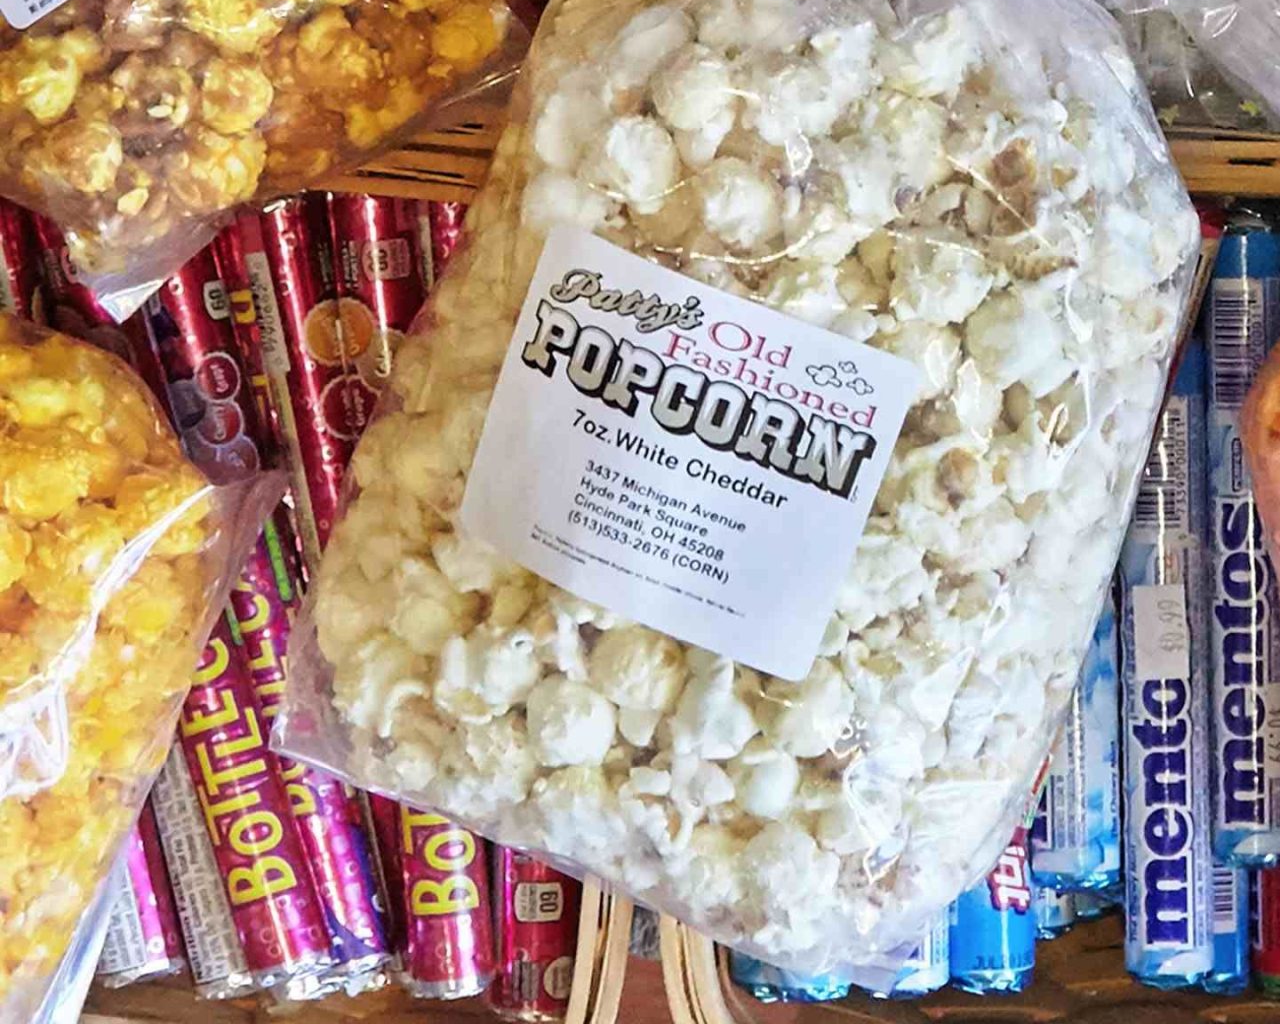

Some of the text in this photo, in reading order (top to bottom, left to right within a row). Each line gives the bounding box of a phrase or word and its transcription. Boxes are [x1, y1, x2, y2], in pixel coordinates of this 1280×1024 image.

[209, 289, 225, 311] 60
[550, 269, 705, 332] Patty's
[708, 320, 793, 369] Old
[522, 299, 877, 500] POPCORN
[661, 330, 878, 429] Fashioned
[579, 476, 709, 538] Hyde Park Square
[584, 459, 747, 533] 3437 Michigan Avenue
[685, 457, 789, 508] Cheddar
[566, 508, 670, 561] (513)533-2676
[671, 553, 730, 585] (CORN)
[571, 492, 725, 562] Cincinnati, OH 45208
[1157, 598, 1185, 652] $0.99
[180, 690, 299, 906] BOTTLE
[1133, 678, 1189, 945] mento
[537, 888, 559, 915] 60
